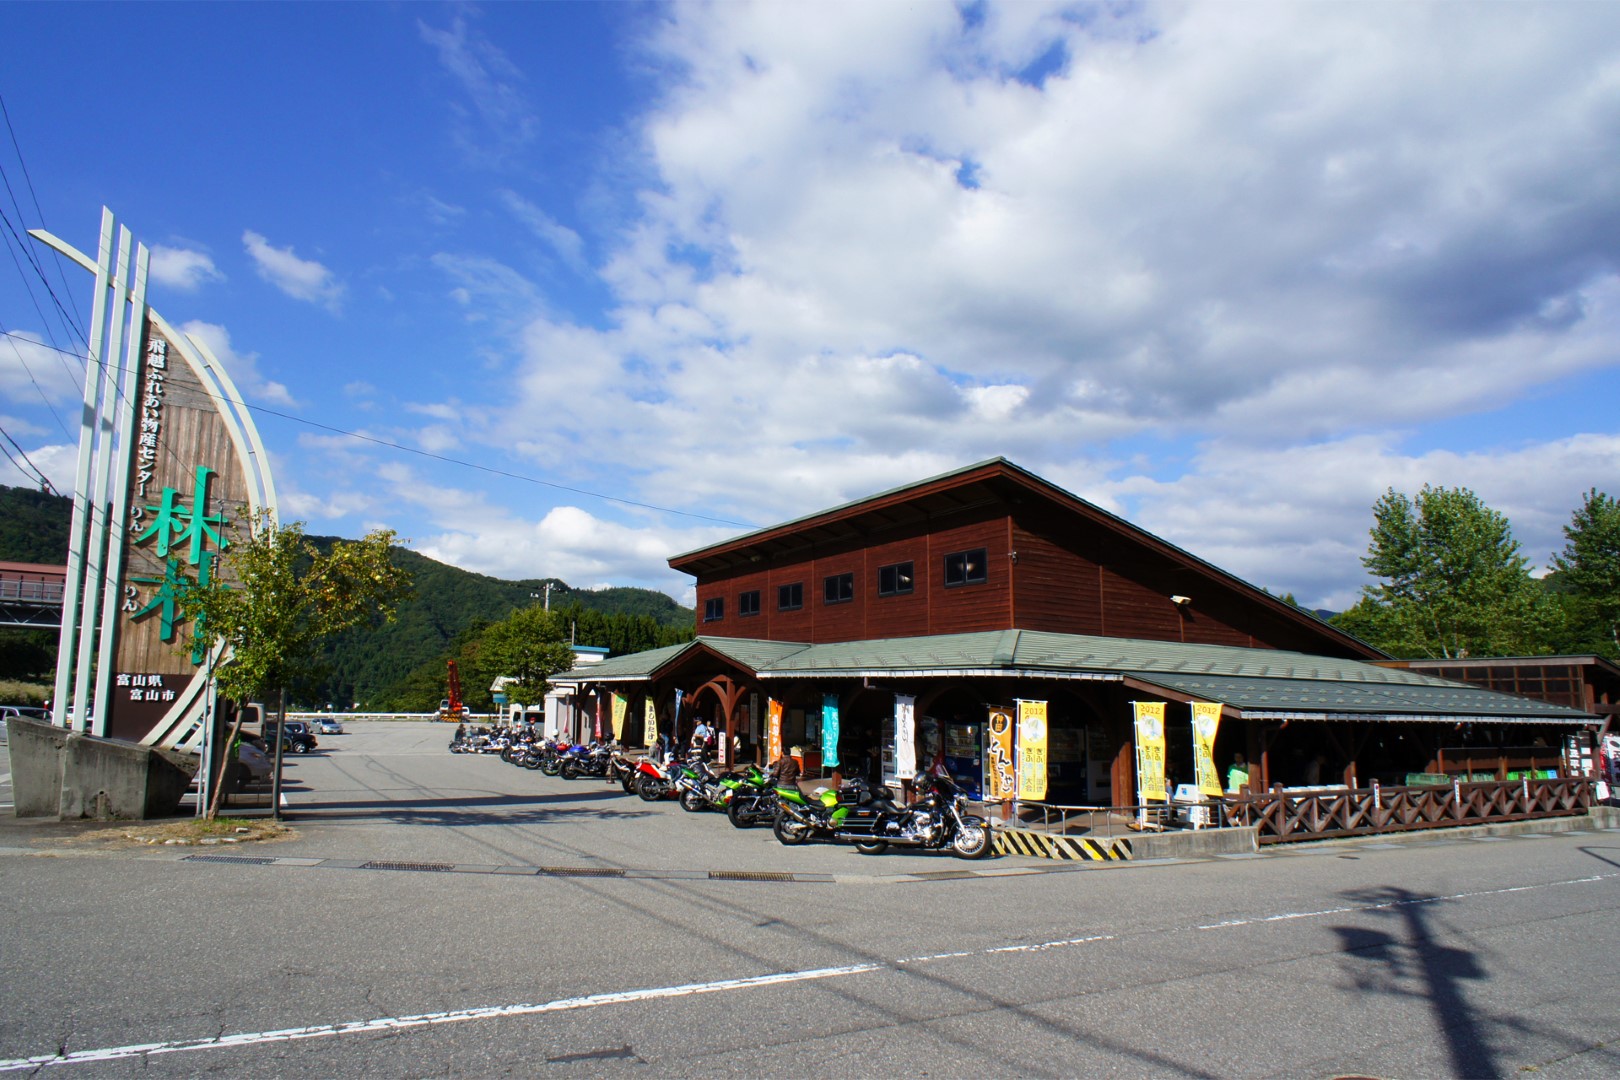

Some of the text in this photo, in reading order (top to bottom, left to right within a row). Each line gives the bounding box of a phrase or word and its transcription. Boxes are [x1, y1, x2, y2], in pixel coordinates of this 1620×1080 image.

[138, 339, 166, 497] 飛越ふれあい物産センター
[129, 506, 144, 532] りん
[134, 466, 230, 565] 林
[122, 585, 138, 612] りん
[116, 673, 163, 687] 富山県
[130, 689, 176, 702] 富山市
[1024, 707, 1044, 716] 2012
[1140, 704, 1161, 715] 2012
[1196, 704, 1217, 715] 2012
